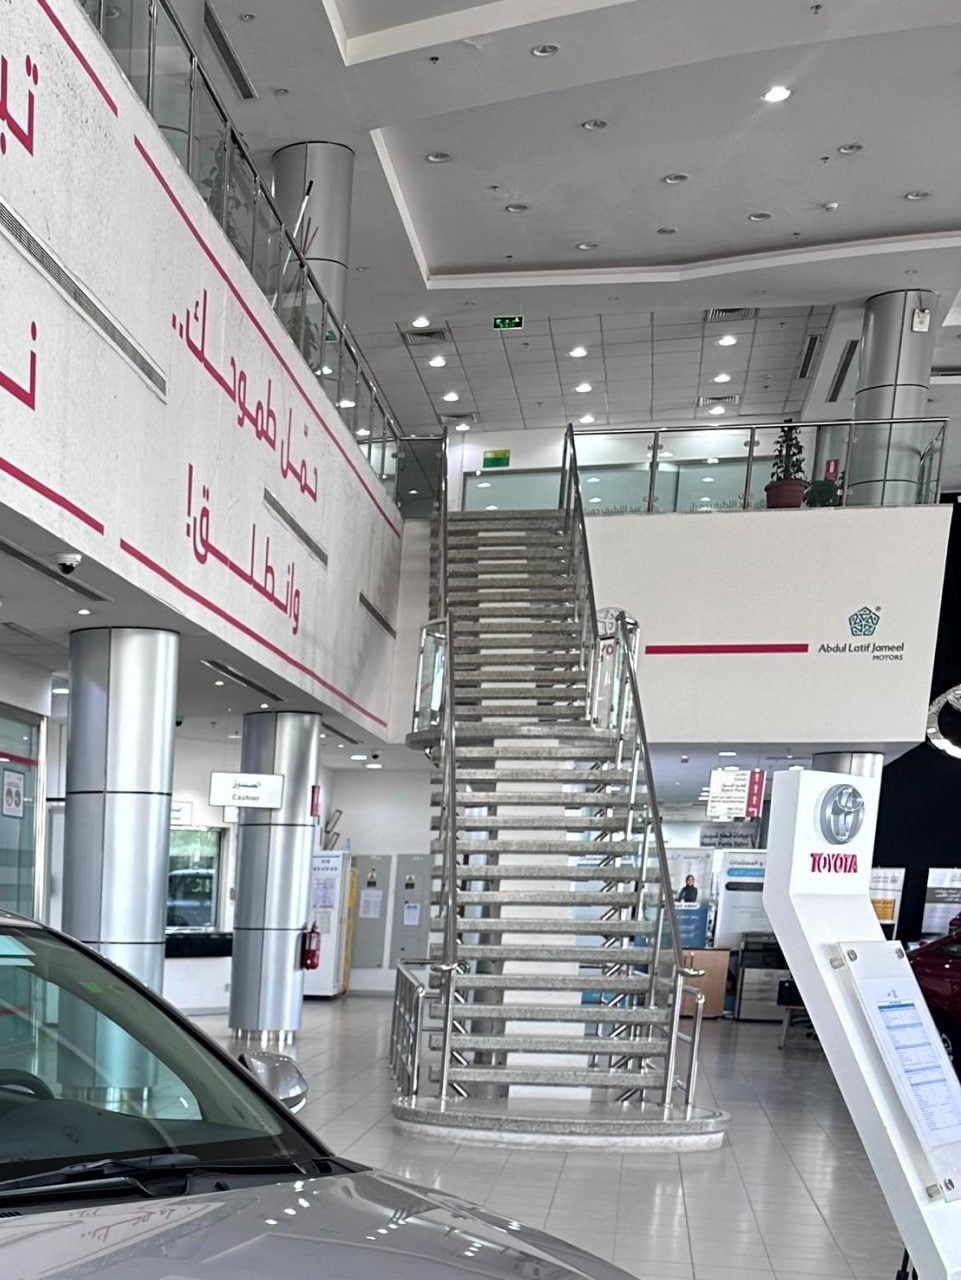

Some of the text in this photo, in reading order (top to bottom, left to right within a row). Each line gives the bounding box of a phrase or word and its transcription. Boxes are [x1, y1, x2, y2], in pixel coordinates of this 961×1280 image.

[818, 642, 905, 653] Abdul Latif Jameel
[232, 793, 260, 801] Cashier
[810, 852, 858, 873] TOYOTA
